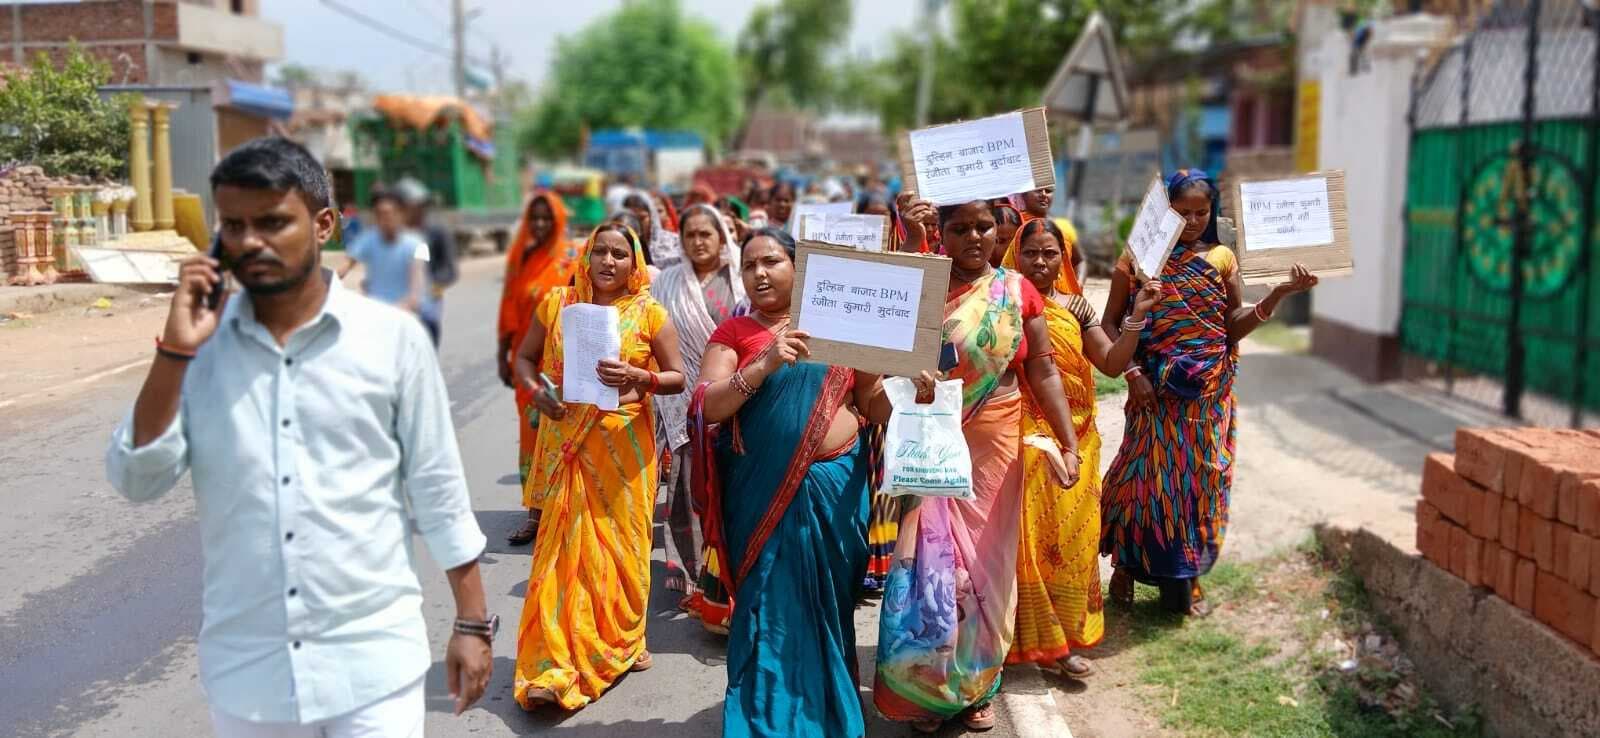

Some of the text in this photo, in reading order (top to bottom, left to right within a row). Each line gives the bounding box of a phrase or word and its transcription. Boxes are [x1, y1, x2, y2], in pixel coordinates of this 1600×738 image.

[926, 138, 1015, 166] दुल्हिन बाजार BPM
[925, 154, 1022, 179] रंजीता कुमारी मुर्दाबाद
[1250, 200, 1271, 210] BPM
[811, 231, 832, 241] BPM
[816, 280, 909, 302] दुल्हिन बाजार BPM
[811, 294, 911, 318] रंजीता कुमारी मुर्दाबाद
[893, 474, 917, 483] Please
[944, 475, 968, 485] Again
